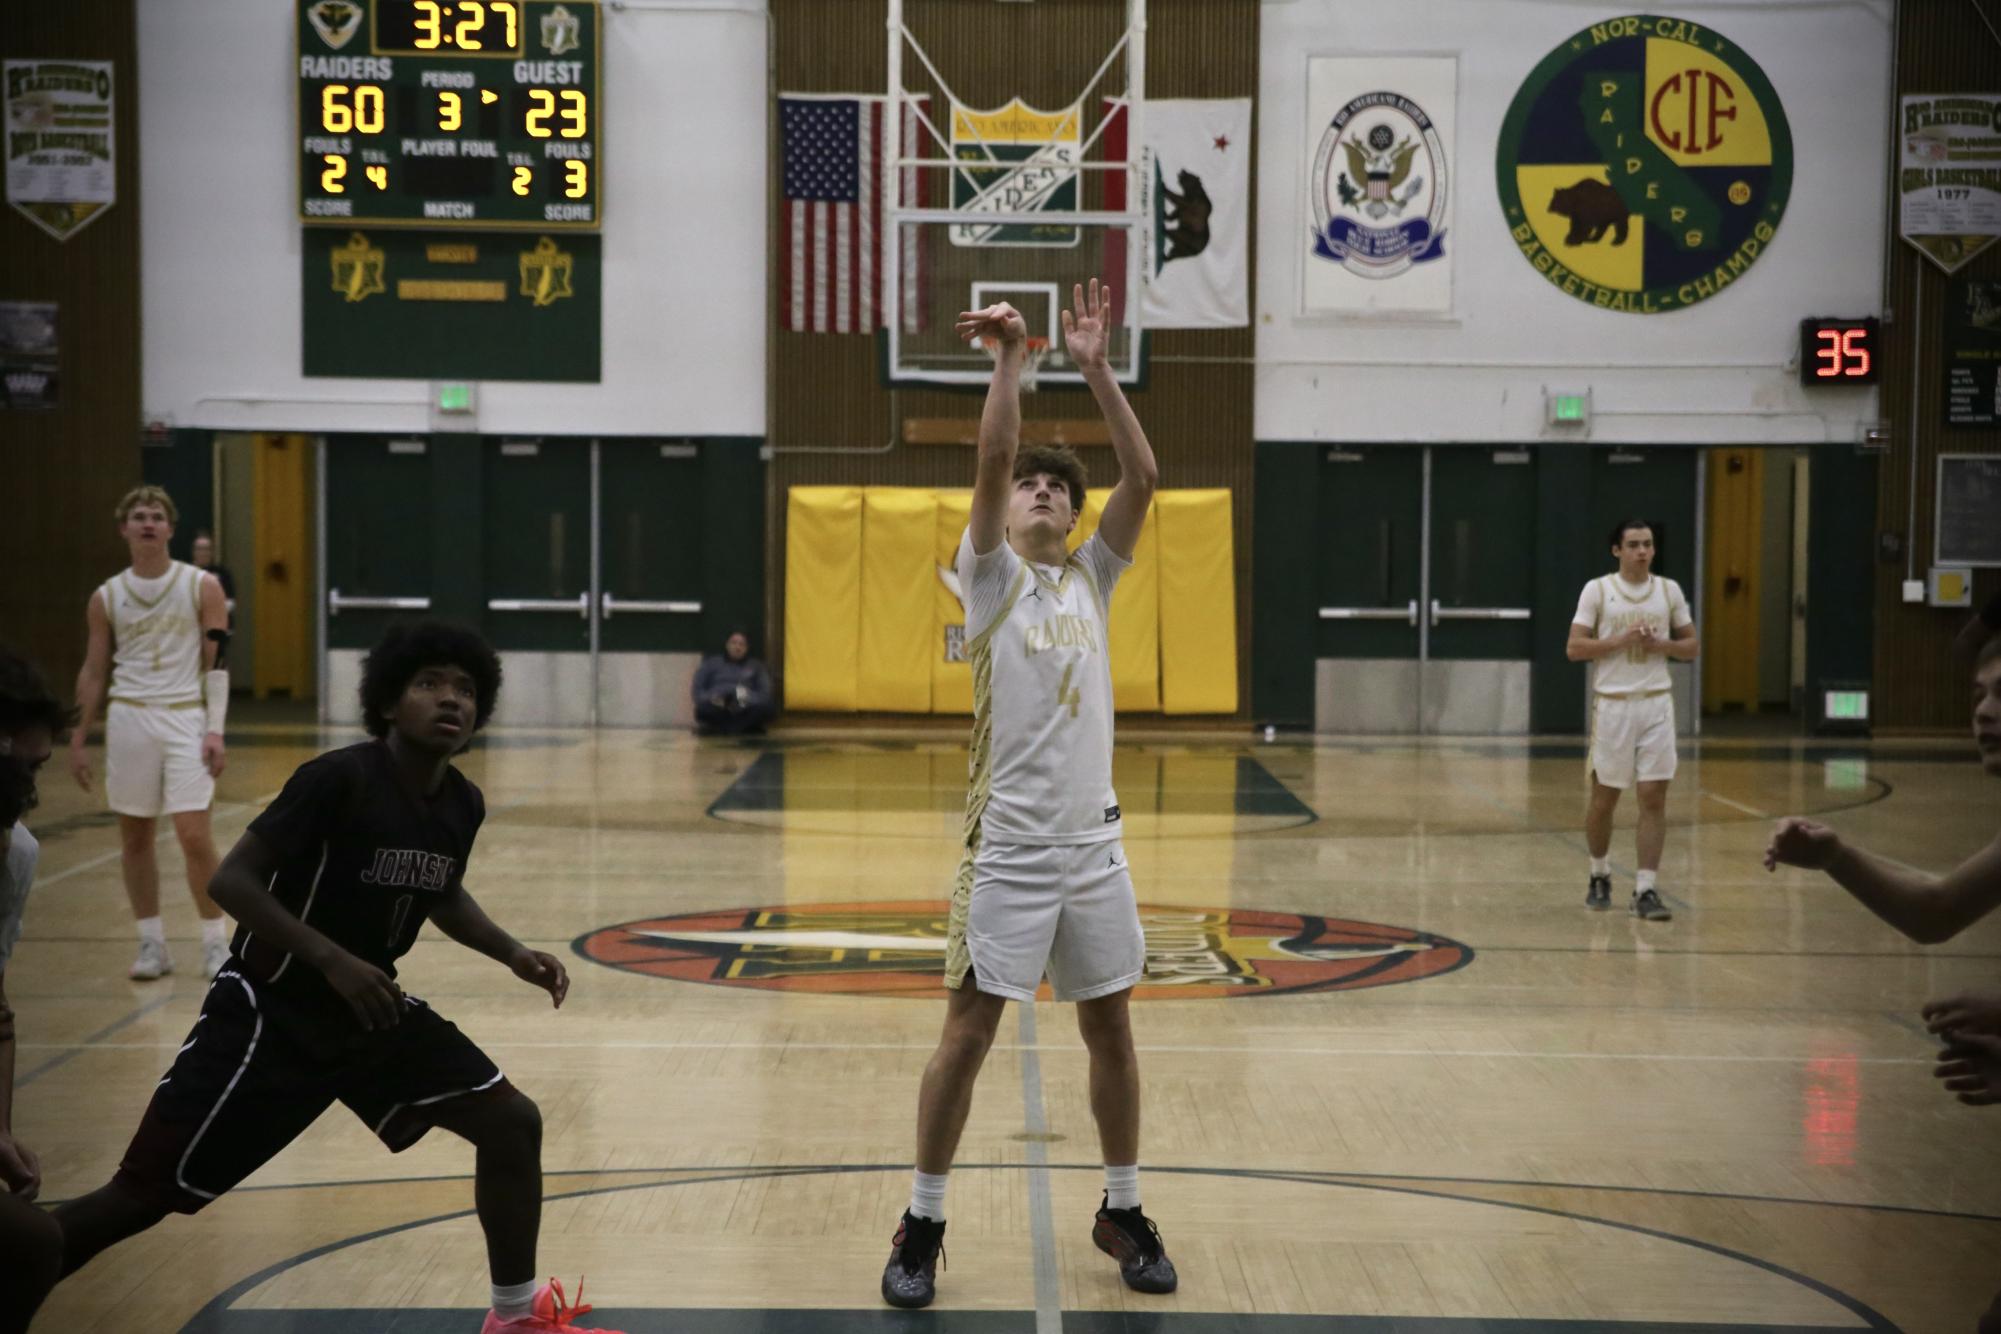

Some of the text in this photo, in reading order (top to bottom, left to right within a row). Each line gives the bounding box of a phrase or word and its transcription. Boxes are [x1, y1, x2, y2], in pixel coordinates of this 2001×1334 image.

[413, 1, 516, 49] 3:27
[1590, 17, 1701, 46] NOR-CAL
[300, 57, 393, 81] RAIDERS
[421, 71, 475, 88] PERIOD
[513, 61, 583, 84] GUEST
[322, 85, 385, 133] 60
[438, 92, 462, 131] 3
[525, 89, 586, 138] 23
[1650, 69, 1737, 154] CIF
[305, 137, 352, 154] FOULS
[401, 140, 498, 158] PLAYER FOUL
[545, 142, 592, 159] FOULS
[321, 154, 347, 193] 2
[365, 166, 387, 190] 4
[512, 166, 532, 195] 2
[565, 160, 587, 198] 3
[305, 201, 352, 217] SCORE
[1938, 190, 1970, 201] 1977
[424, 203, 475, 218] MATCH
[545, 204, 591, 220] SCORE
[1817, 329, 1870, 376] 35
[1057, 663, 1081, 718] 4
[387, 894, 414, 949] 1
